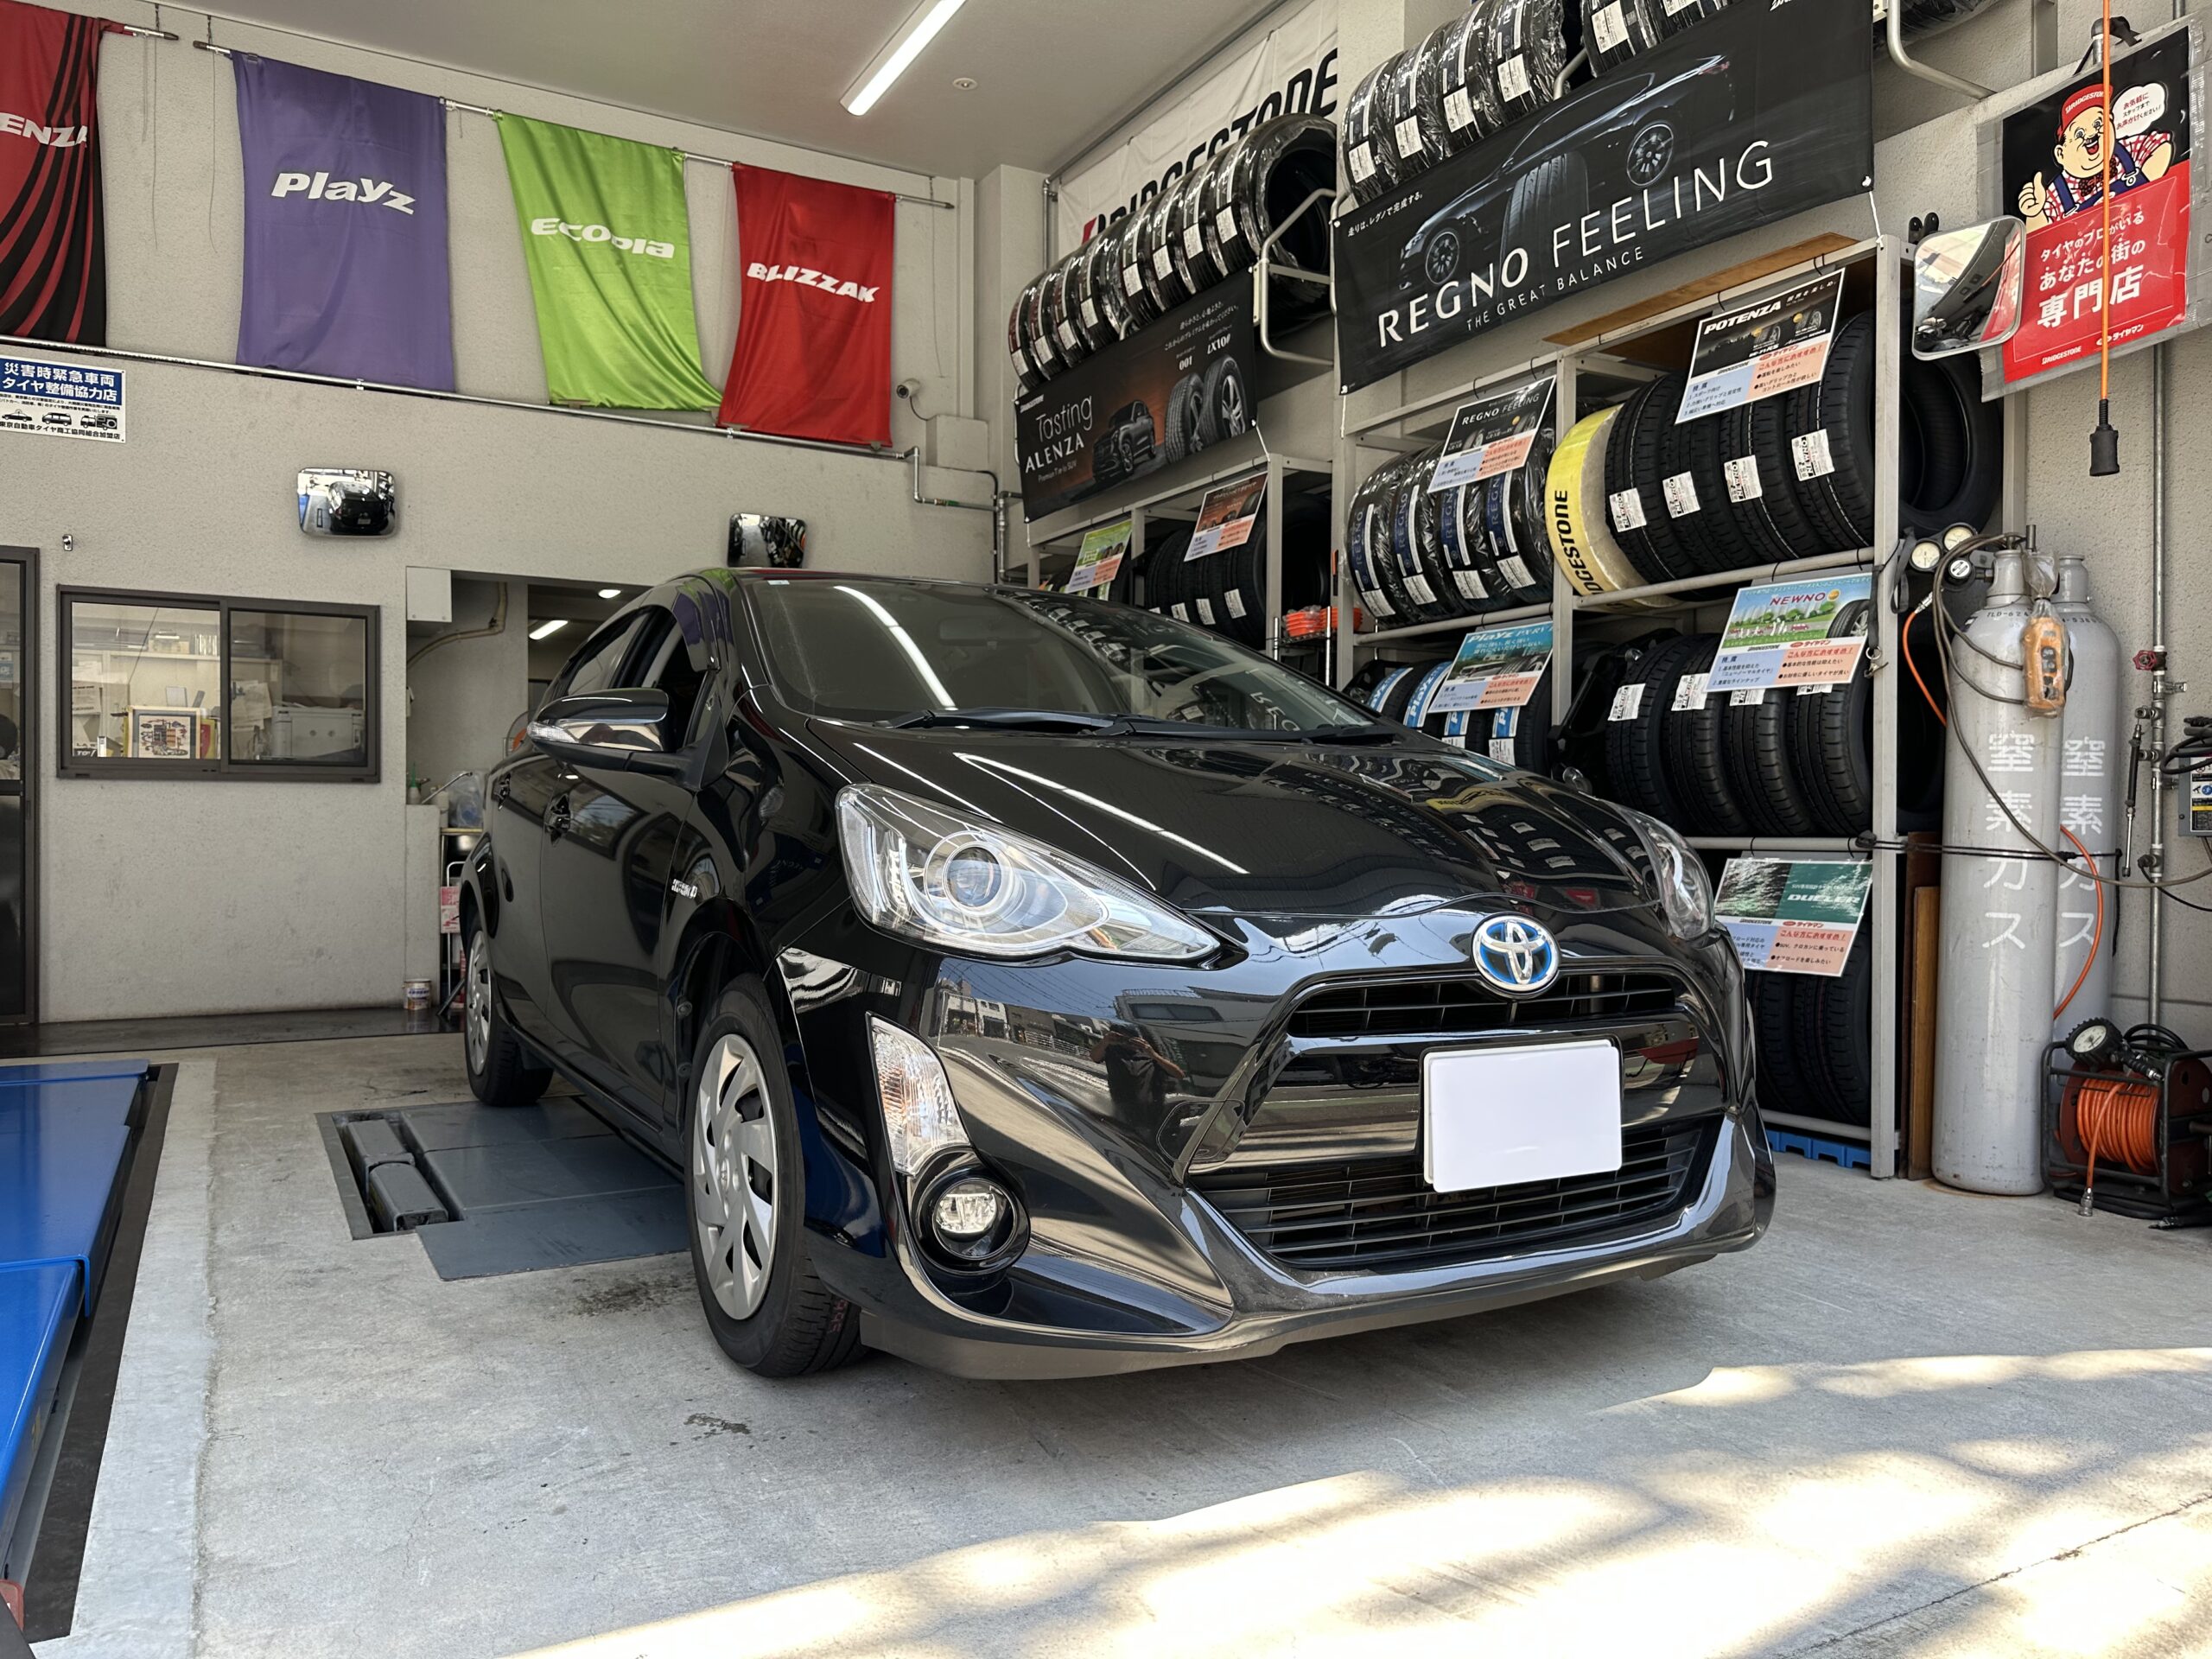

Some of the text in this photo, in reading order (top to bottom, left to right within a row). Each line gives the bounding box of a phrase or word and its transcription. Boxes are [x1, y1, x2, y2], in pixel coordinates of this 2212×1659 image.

[2065, 91, 2105, 114] BRIDGESTO
[270, 172, 416, 215] Playz
[1377, 140, 1773, 347] REGNO FEELING
[747, 263, 880, 302] BLIZZAK
[1466, 246, 1644, 333] THE GREAT BALANCE
[2037, 264, 2144, 328] 専門店
[1704, 301, 1782, 335] POTENZA
[4, 362, 115, 387] 災害時緊急車両
[2042, 346, 2082, 365] BRIDGESTONE
[3, 377, 118, 402] タイヤ整備協力店
[1462, 408, 1499, 425] REGNO
[1502, 393, 1540, 413] FEELING
[1036, 396, 1092, 442] Tasting
[1026, 433, 1084, 473] ALENZA
[1491, 478, 1500, 525] REGN
[1554, 490, 1604, 594] DGESTONE
[1770, 592, 1826, 606] NEWNO
